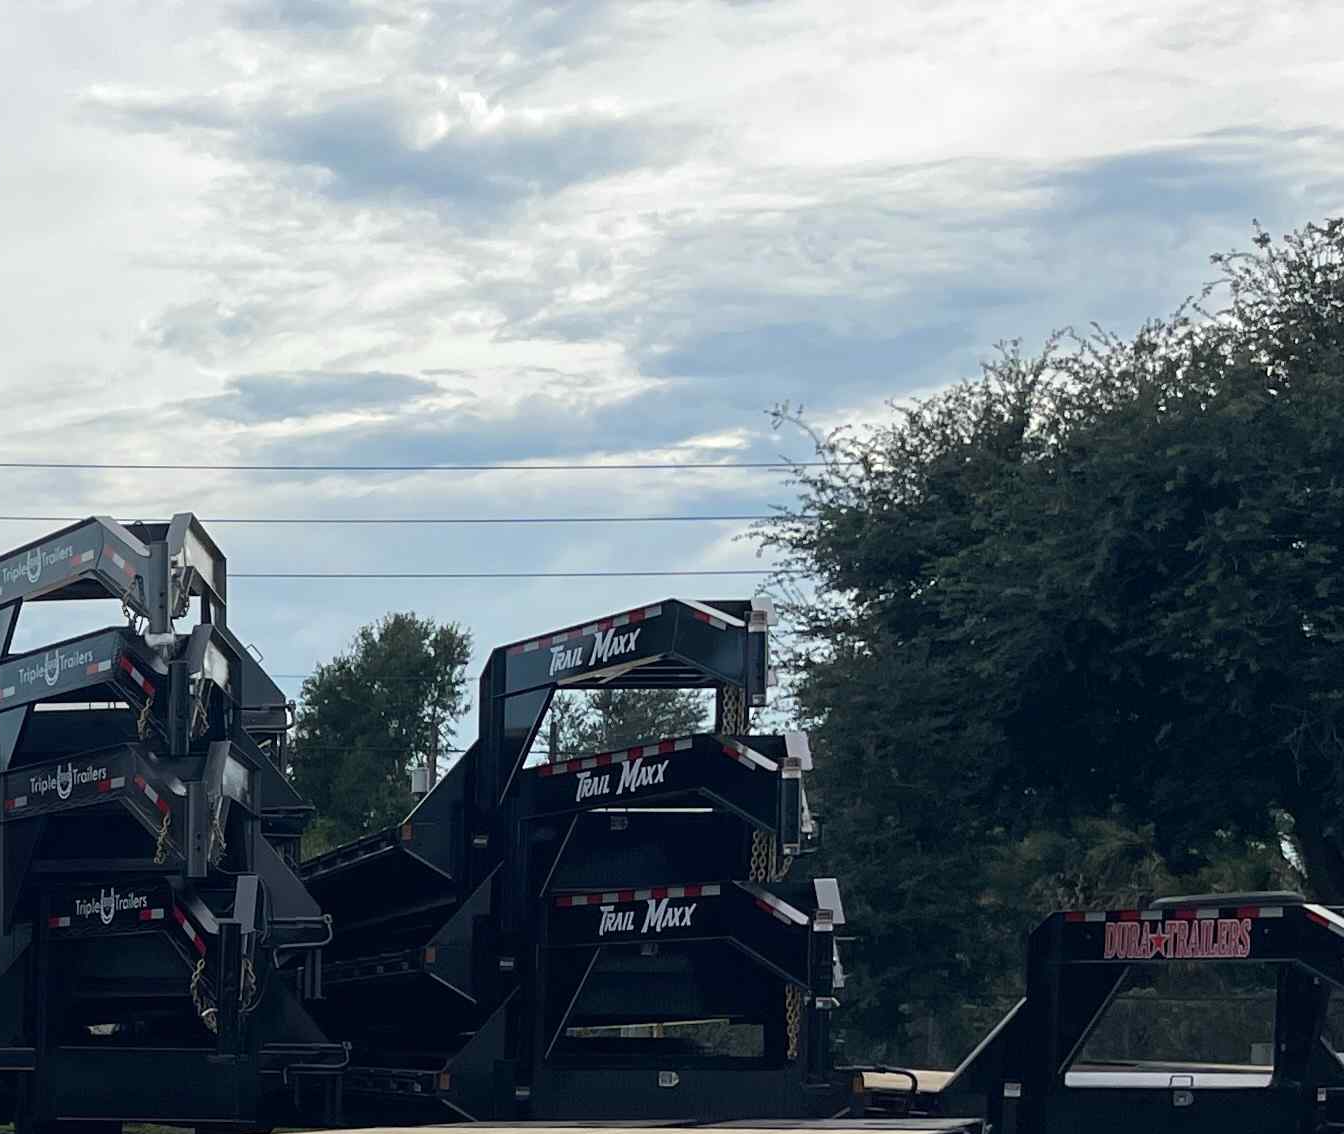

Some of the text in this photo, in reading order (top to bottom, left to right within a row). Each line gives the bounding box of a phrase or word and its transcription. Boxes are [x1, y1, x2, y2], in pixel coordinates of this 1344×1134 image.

[2, 562, 28, 584] Triple
[18, 663, 44, 685] Triple
[60, 650, 93, 671] Trailers
[30, 774, 56, 796] Triple
[73, 766, 107, 785] Trailers
[75, 898, 100, 919] Triple
[115, 892, 148, 911] Trailers
[1103, 918, 1252, 960] DURA TRAILERS
